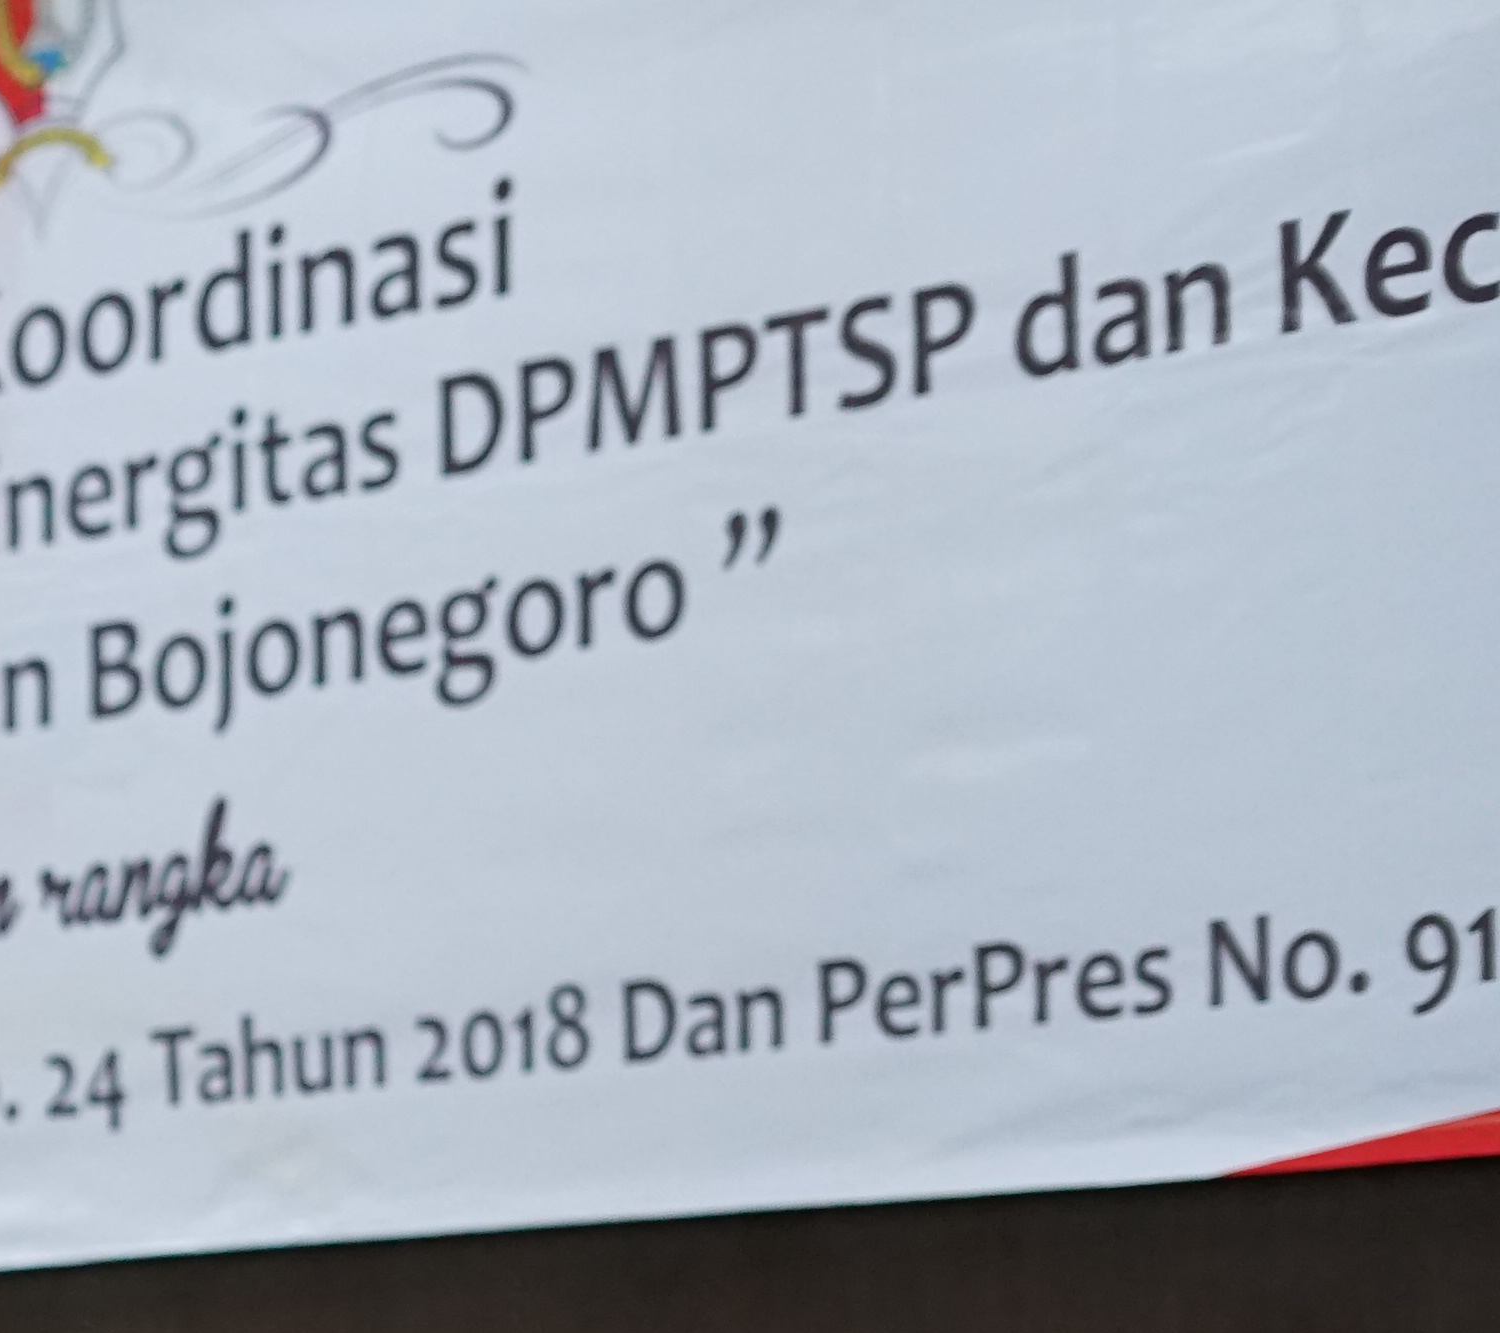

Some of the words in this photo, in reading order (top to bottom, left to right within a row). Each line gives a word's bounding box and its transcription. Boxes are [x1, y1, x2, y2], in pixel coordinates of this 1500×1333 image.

[438, 282, 977, 478] DPMPTSP
[1014, 252, 1231, 379] dan
[88, 559, 686, 733] Bojonegoro
[38, 798, 289, 959] rangka
[46, 1050, 127, 1130] 24
[150, 1015, 387, 1106] Tahun
[416, 983, 591, 1083] 2018
[621, 978, 785, 1064] Dan
[816, 940, 1174, 1044] PerPres
[1207, 912, 1371, 1008] No.
[1404, 907, 1497, 1016] 91
